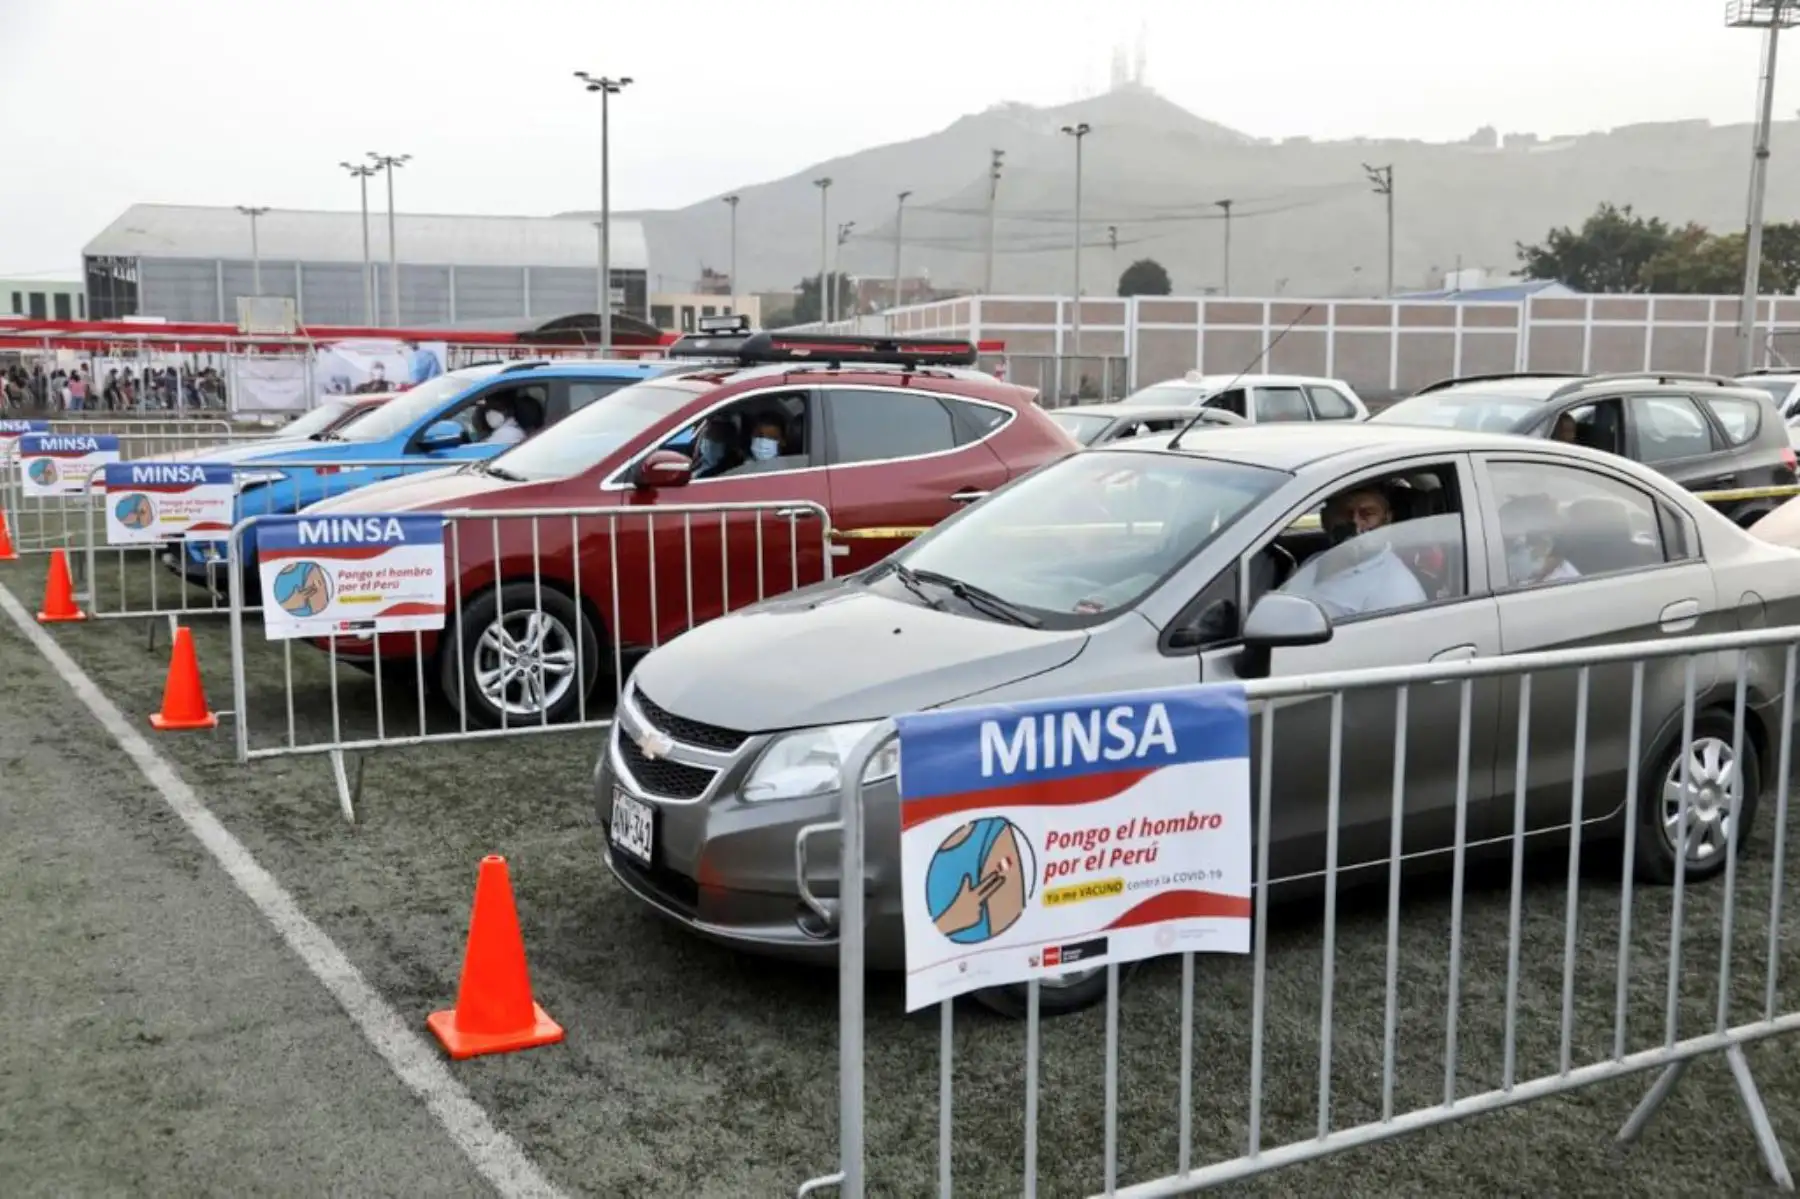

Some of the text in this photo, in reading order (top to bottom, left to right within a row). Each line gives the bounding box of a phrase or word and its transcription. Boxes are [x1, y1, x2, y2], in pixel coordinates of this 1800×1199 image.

[41, 437, 98, 450] MINSA
[132, 466, 207, 482] MINSA
[299, 518, 405, 544] MINSA
[980, 703, 1177, 777] MINSA
[1046, 811, 1222, 850] Pongo el hombro
[1043, 842, 1159, 885] por el Perú
[1079, 880, 1123, 897] VACUNO
[1127, 879, 1160, 891] contra
[1162, 875, 1170, 884] la
